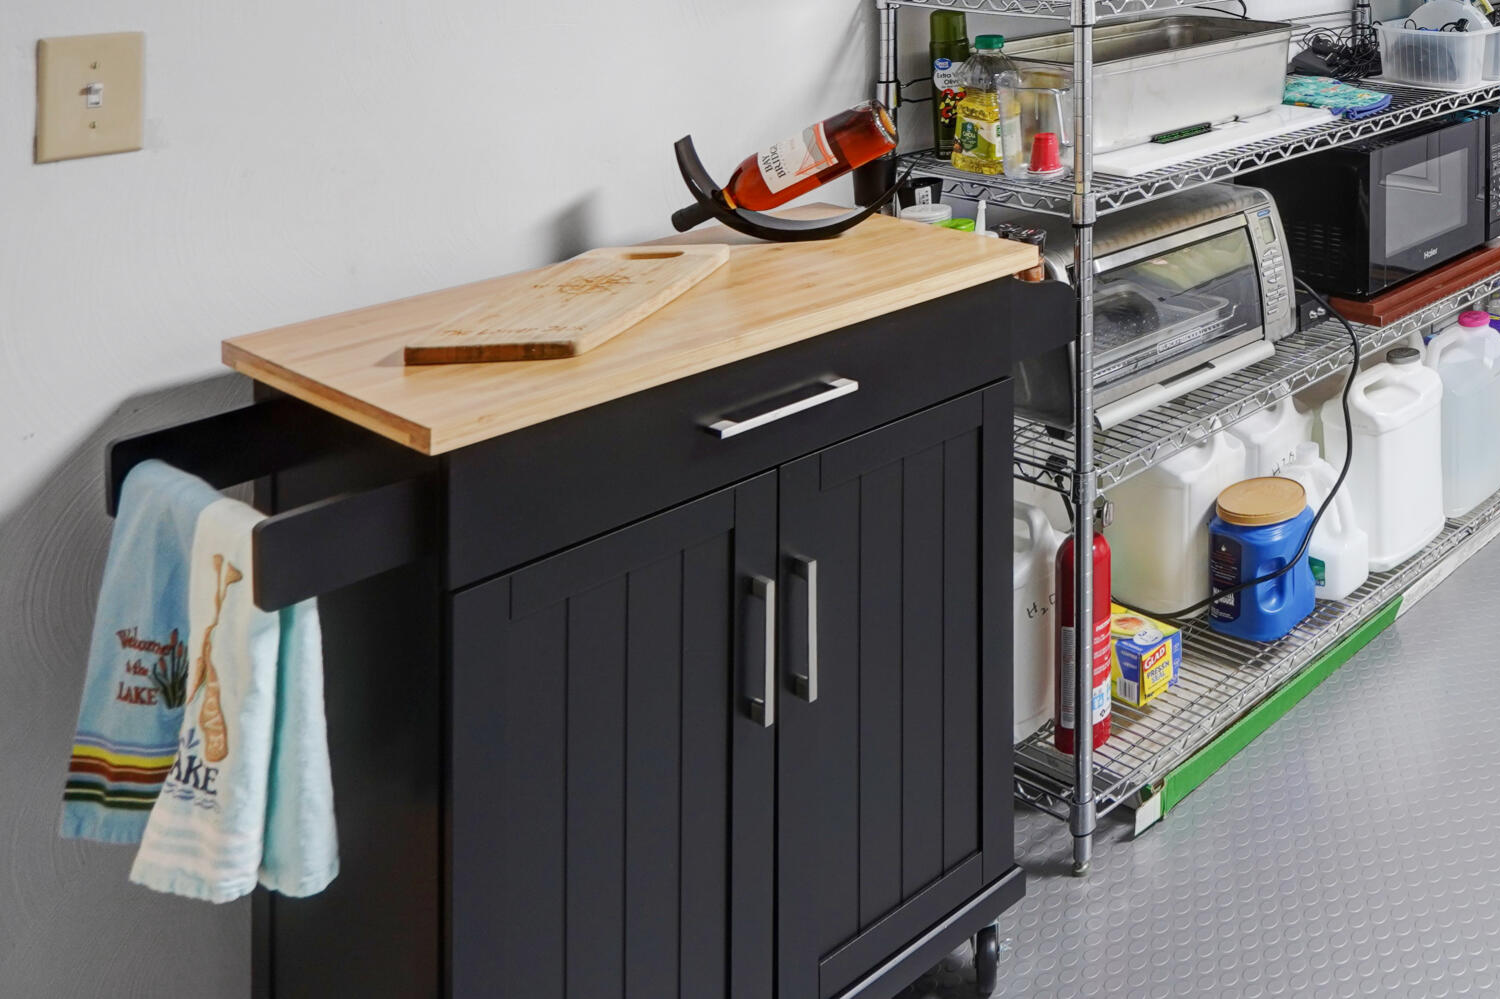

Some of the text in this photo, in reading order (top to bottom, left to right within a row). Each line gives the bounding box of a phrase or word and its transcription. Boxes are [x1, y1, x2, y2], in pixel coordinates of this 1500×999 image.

[1423, 247, 1438, 260] Haier
[1144, 646, 1166, 669] GLAD
[116, 681, 160, 706] LAKE
[169, 752, 219, 796] AKE
